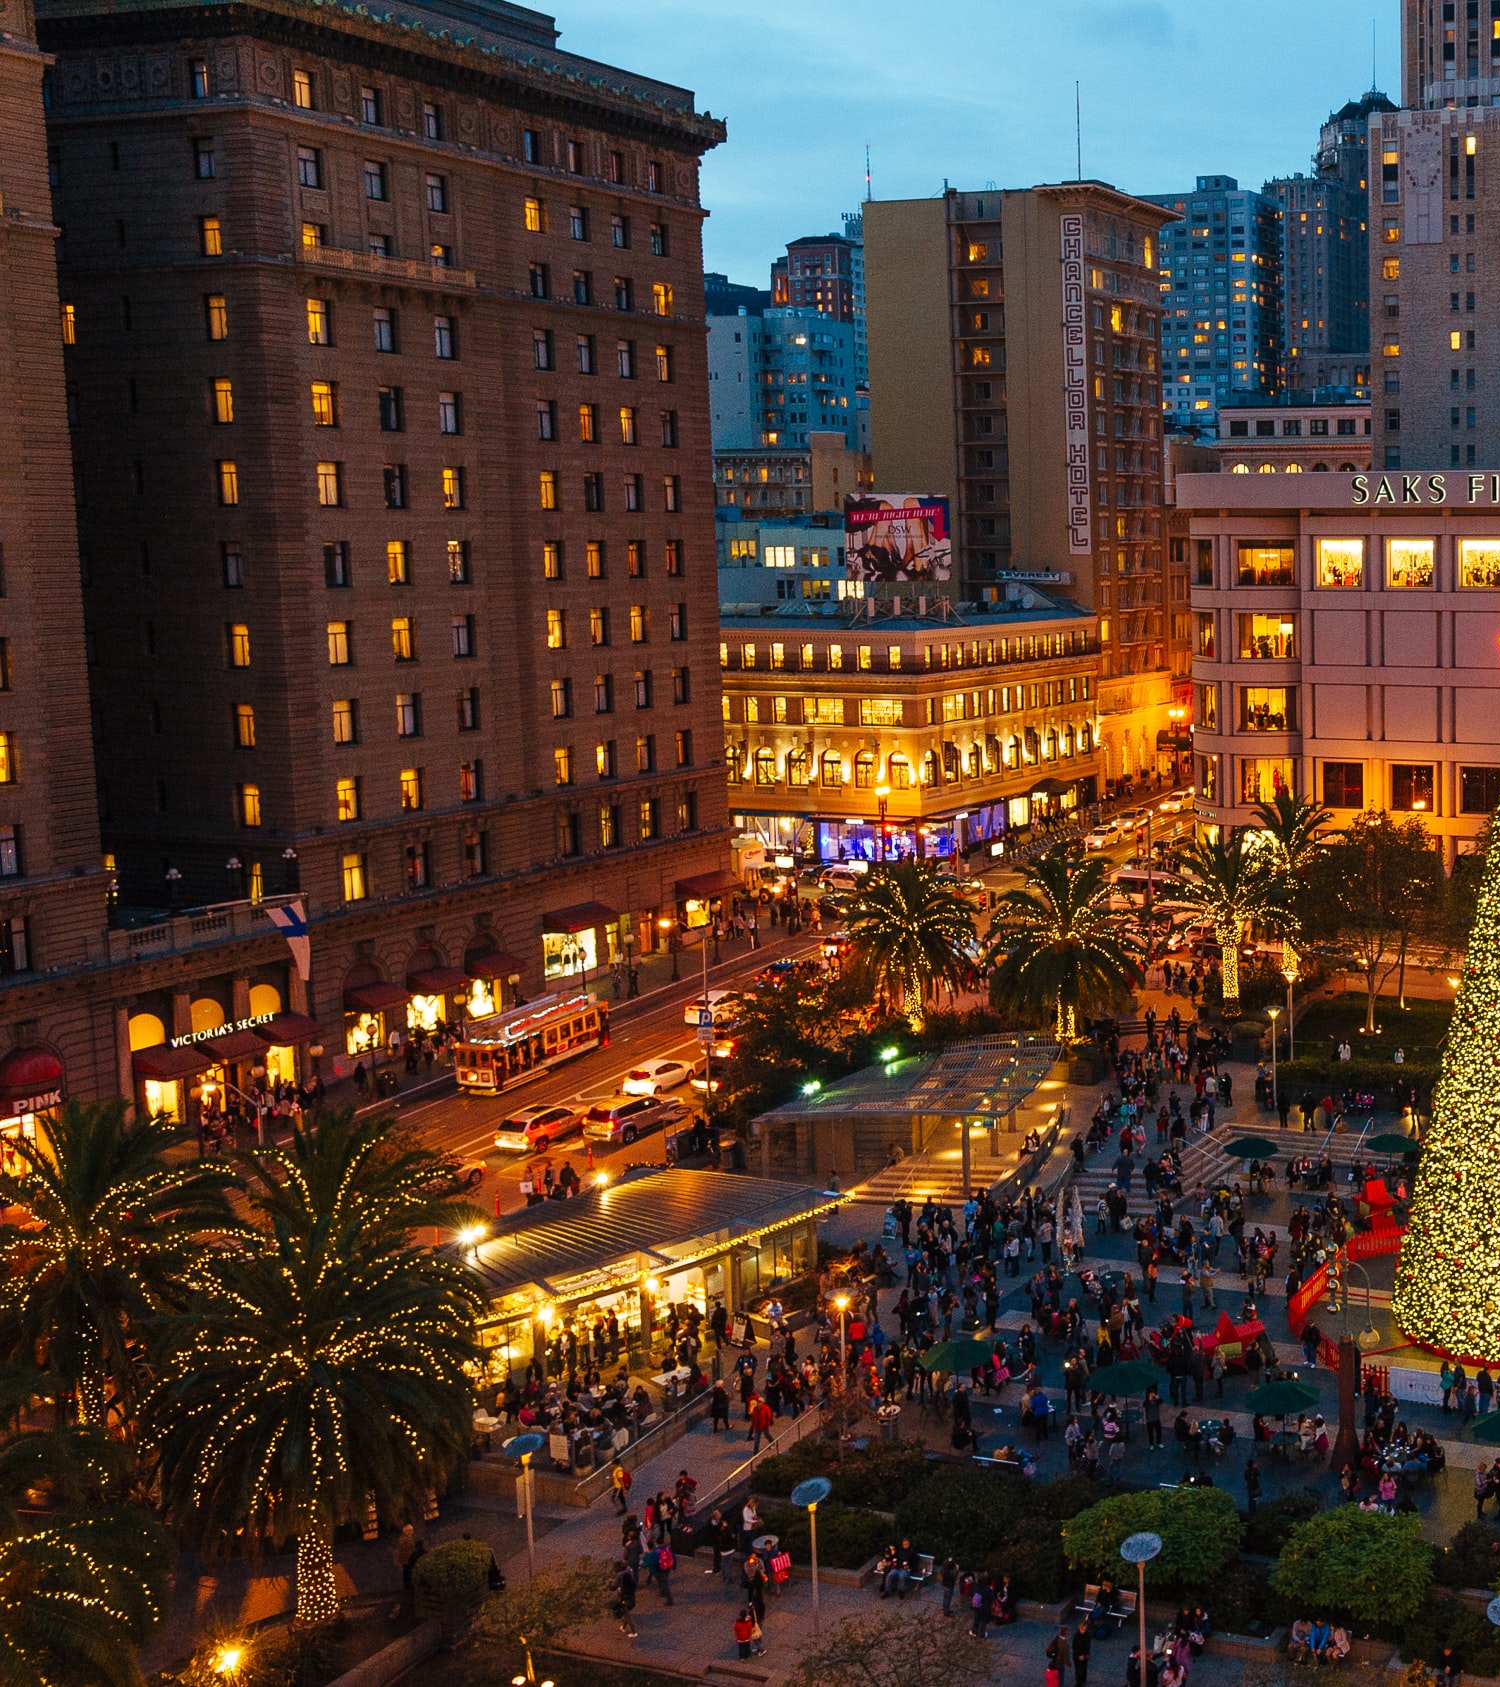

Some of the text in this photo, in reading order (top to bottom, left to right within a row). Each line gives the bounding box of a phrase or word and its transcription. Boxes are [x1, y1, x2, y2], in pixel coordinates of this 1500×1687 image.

[1063, 217, 1088, 547] CHANCELLOR HOTEL
[1351, 474, 1446, 504] SAKS
[883, 510, 911, 519] RIGHT
[913, 508, 940, 517] HERE!
[888, 525, 911, 534] DSW
[171, 1012, 275, 1048] VICTORIA'S SECRET
[13, 1089, 62, 1114] PINK
